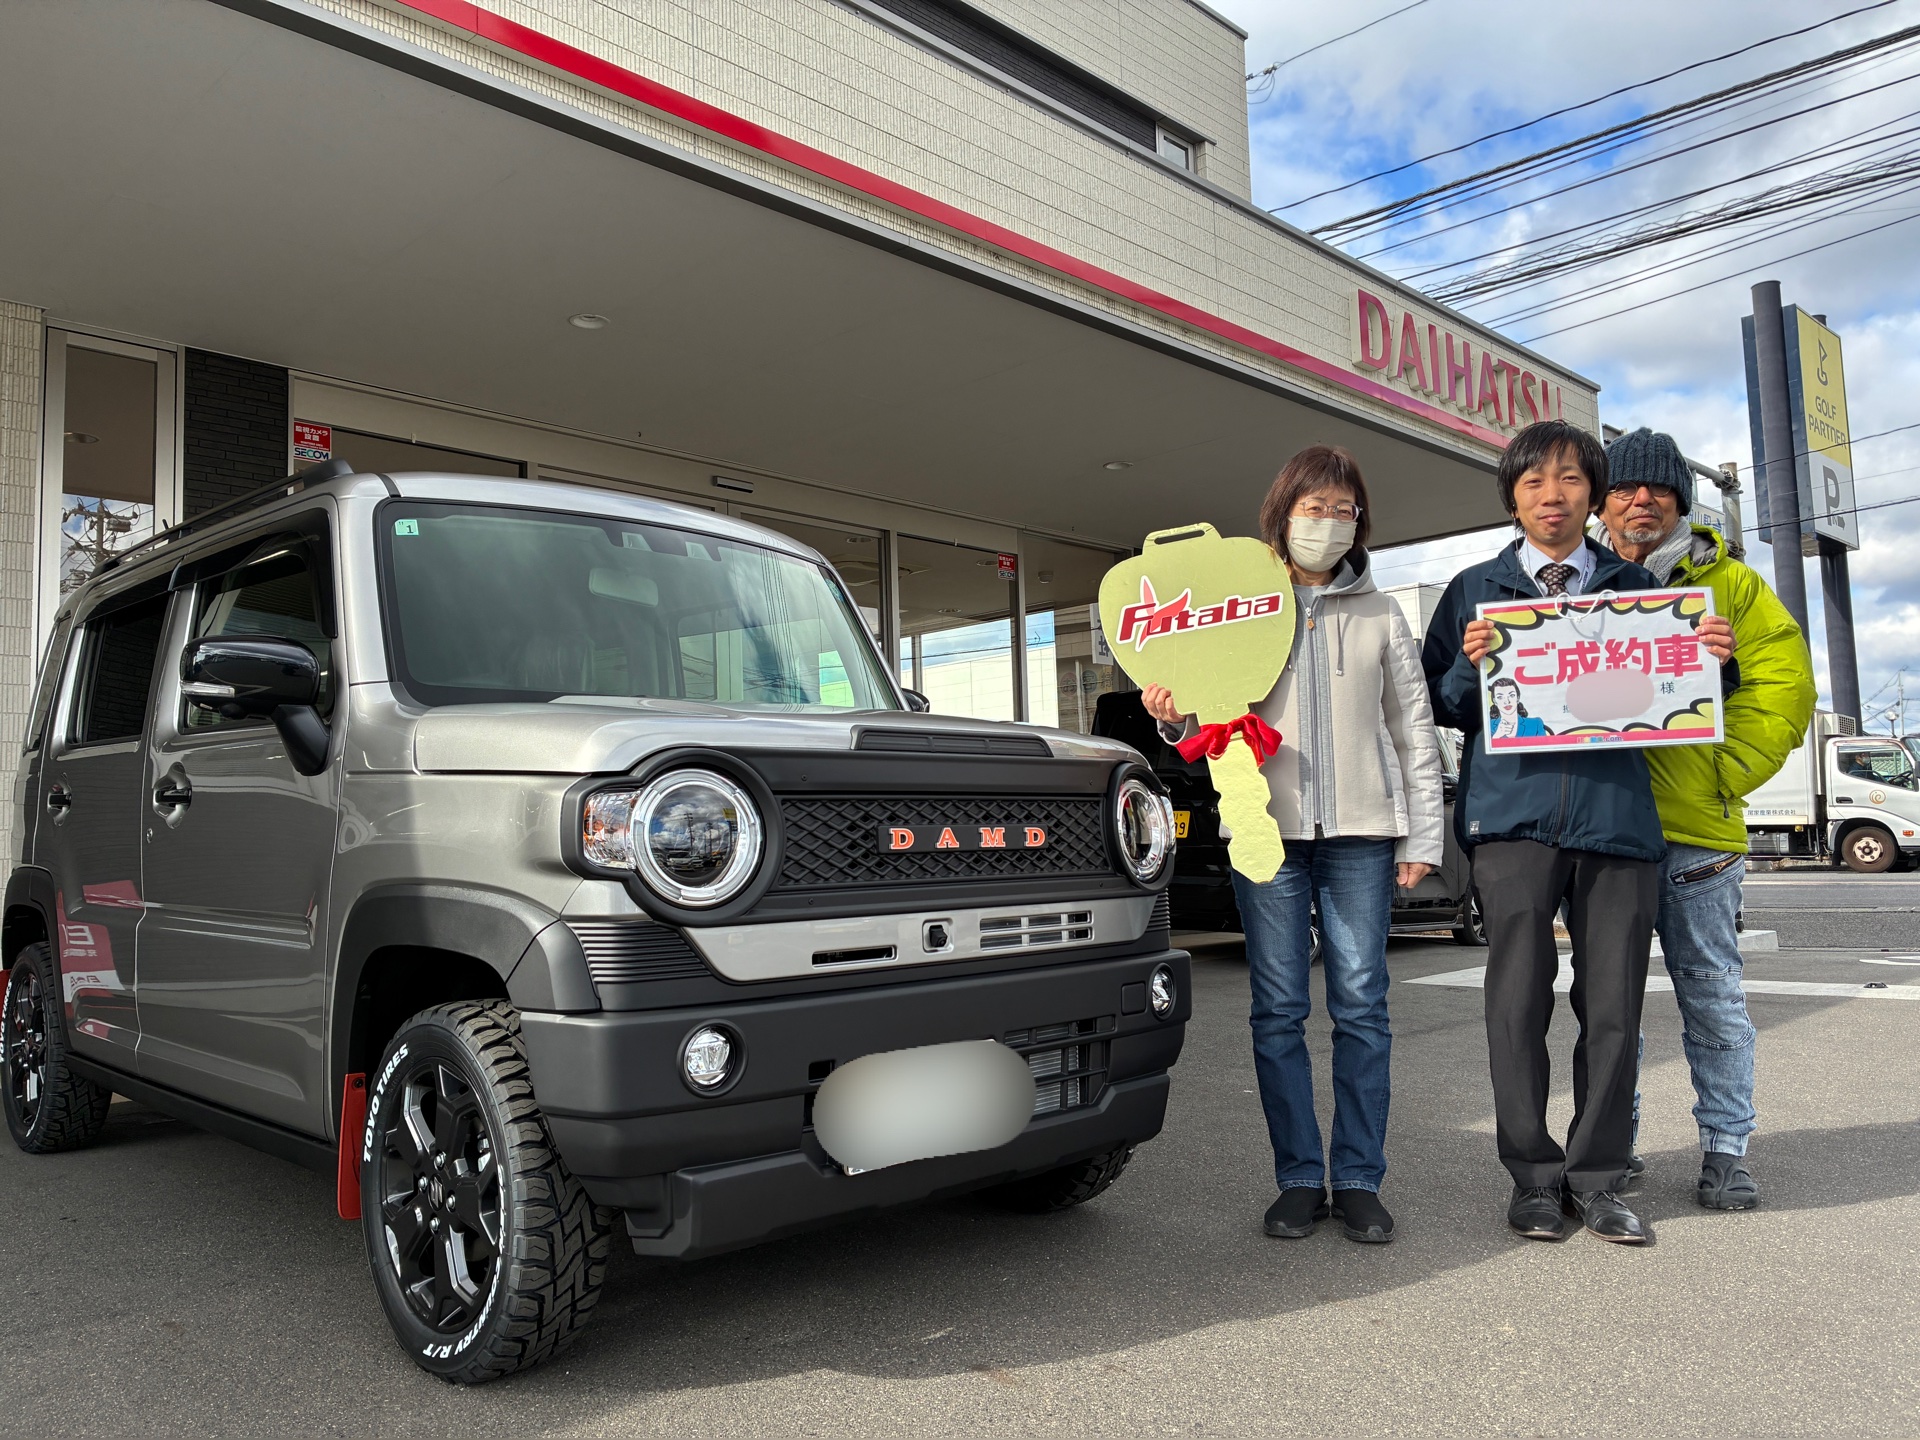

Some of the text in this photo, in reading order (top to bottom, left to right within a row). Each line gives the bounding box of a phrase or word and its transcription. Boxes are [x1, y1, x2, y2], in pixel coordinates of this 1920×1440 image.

[1356, 288, 1563, 428] DAIHATSU
[1815, 395, 1837, 421] GOLF
[1808, 413, 1847, 450] PARTNER
[294, 447, 330, 460] SECOM
[1822, 465, 1841, 527] P
[406, 525, 414, 534] 1
[1118, 590, 1282, 644] Futaba
[1514, 633, 1704, 686] ご成約車
[1660, 681, 1675, 695] 様
[889, 827, 1046, 850] DAMD
[363, 1042, 410, 1163] TOYO TIRES
[422, 1342, 453, 1359] R/T
